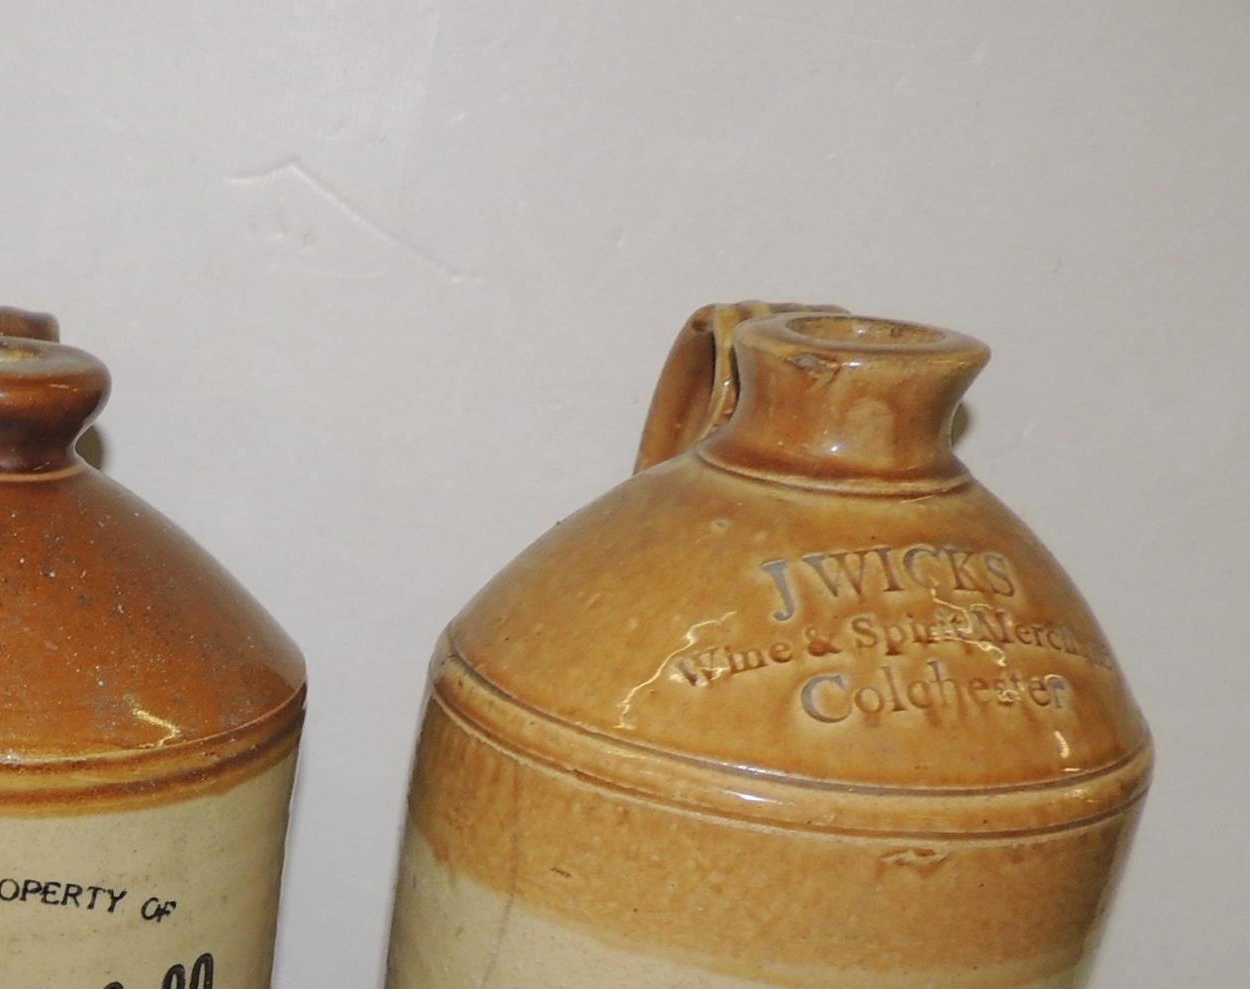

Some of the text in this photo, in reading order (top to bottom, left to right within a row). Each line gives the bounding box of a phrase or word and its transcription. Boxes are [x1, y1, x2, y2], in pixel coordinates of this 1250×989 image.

[672, 643, 794, 688] Wine
[805, 626, 843, 657] &
[800, 660, 1067, 724] Colchester
[140, 896, 177, 923] OF
